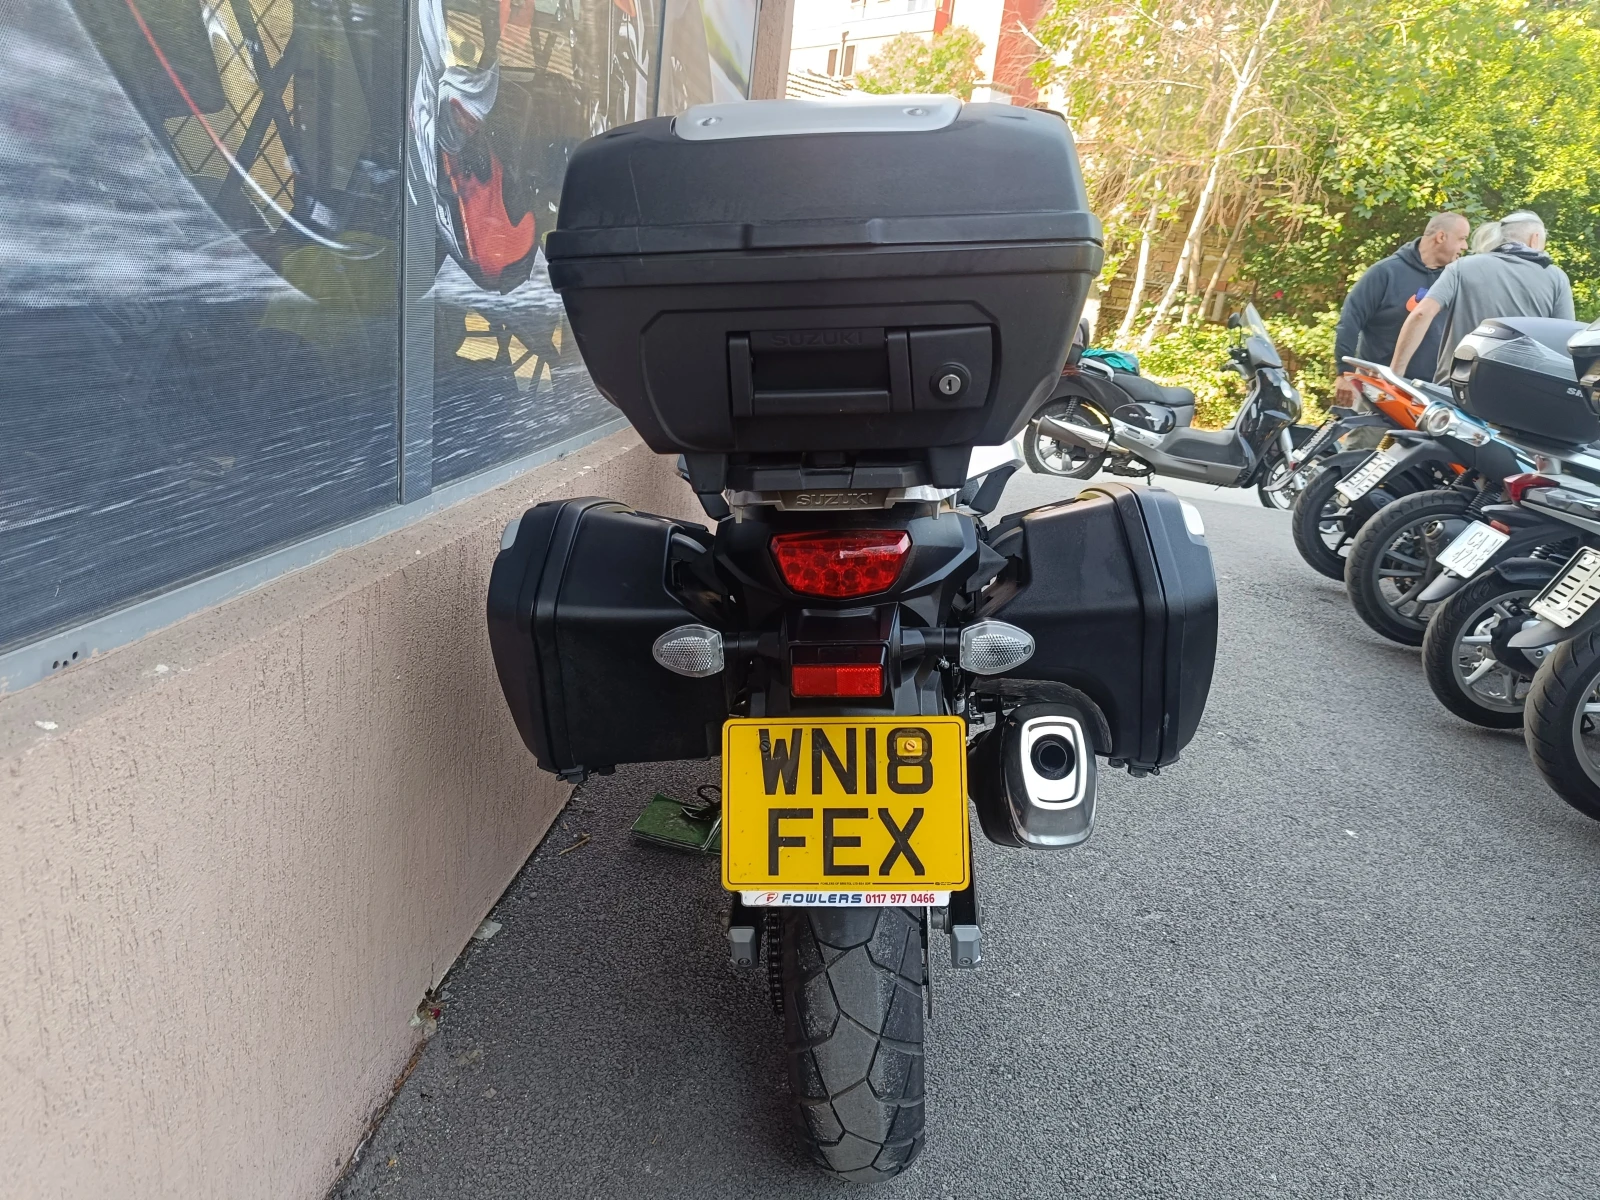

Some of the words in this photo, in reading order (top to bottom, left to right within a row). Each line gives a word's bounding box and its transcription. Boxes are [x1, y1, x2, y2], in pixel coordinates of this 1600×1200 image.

[770, 331, 864, 348] SUZUKI
[796, 492, 873, 507] SUZUKI
[758, 727, 934, 795] WN18
[768, 808, 926, 876] FEX
[782, 893, 863, 904] FOWLERS
[865, 893, 887, 904] 0117
[890, 893, 907, 904] 977
[910, 893, 935, 904] 0466
